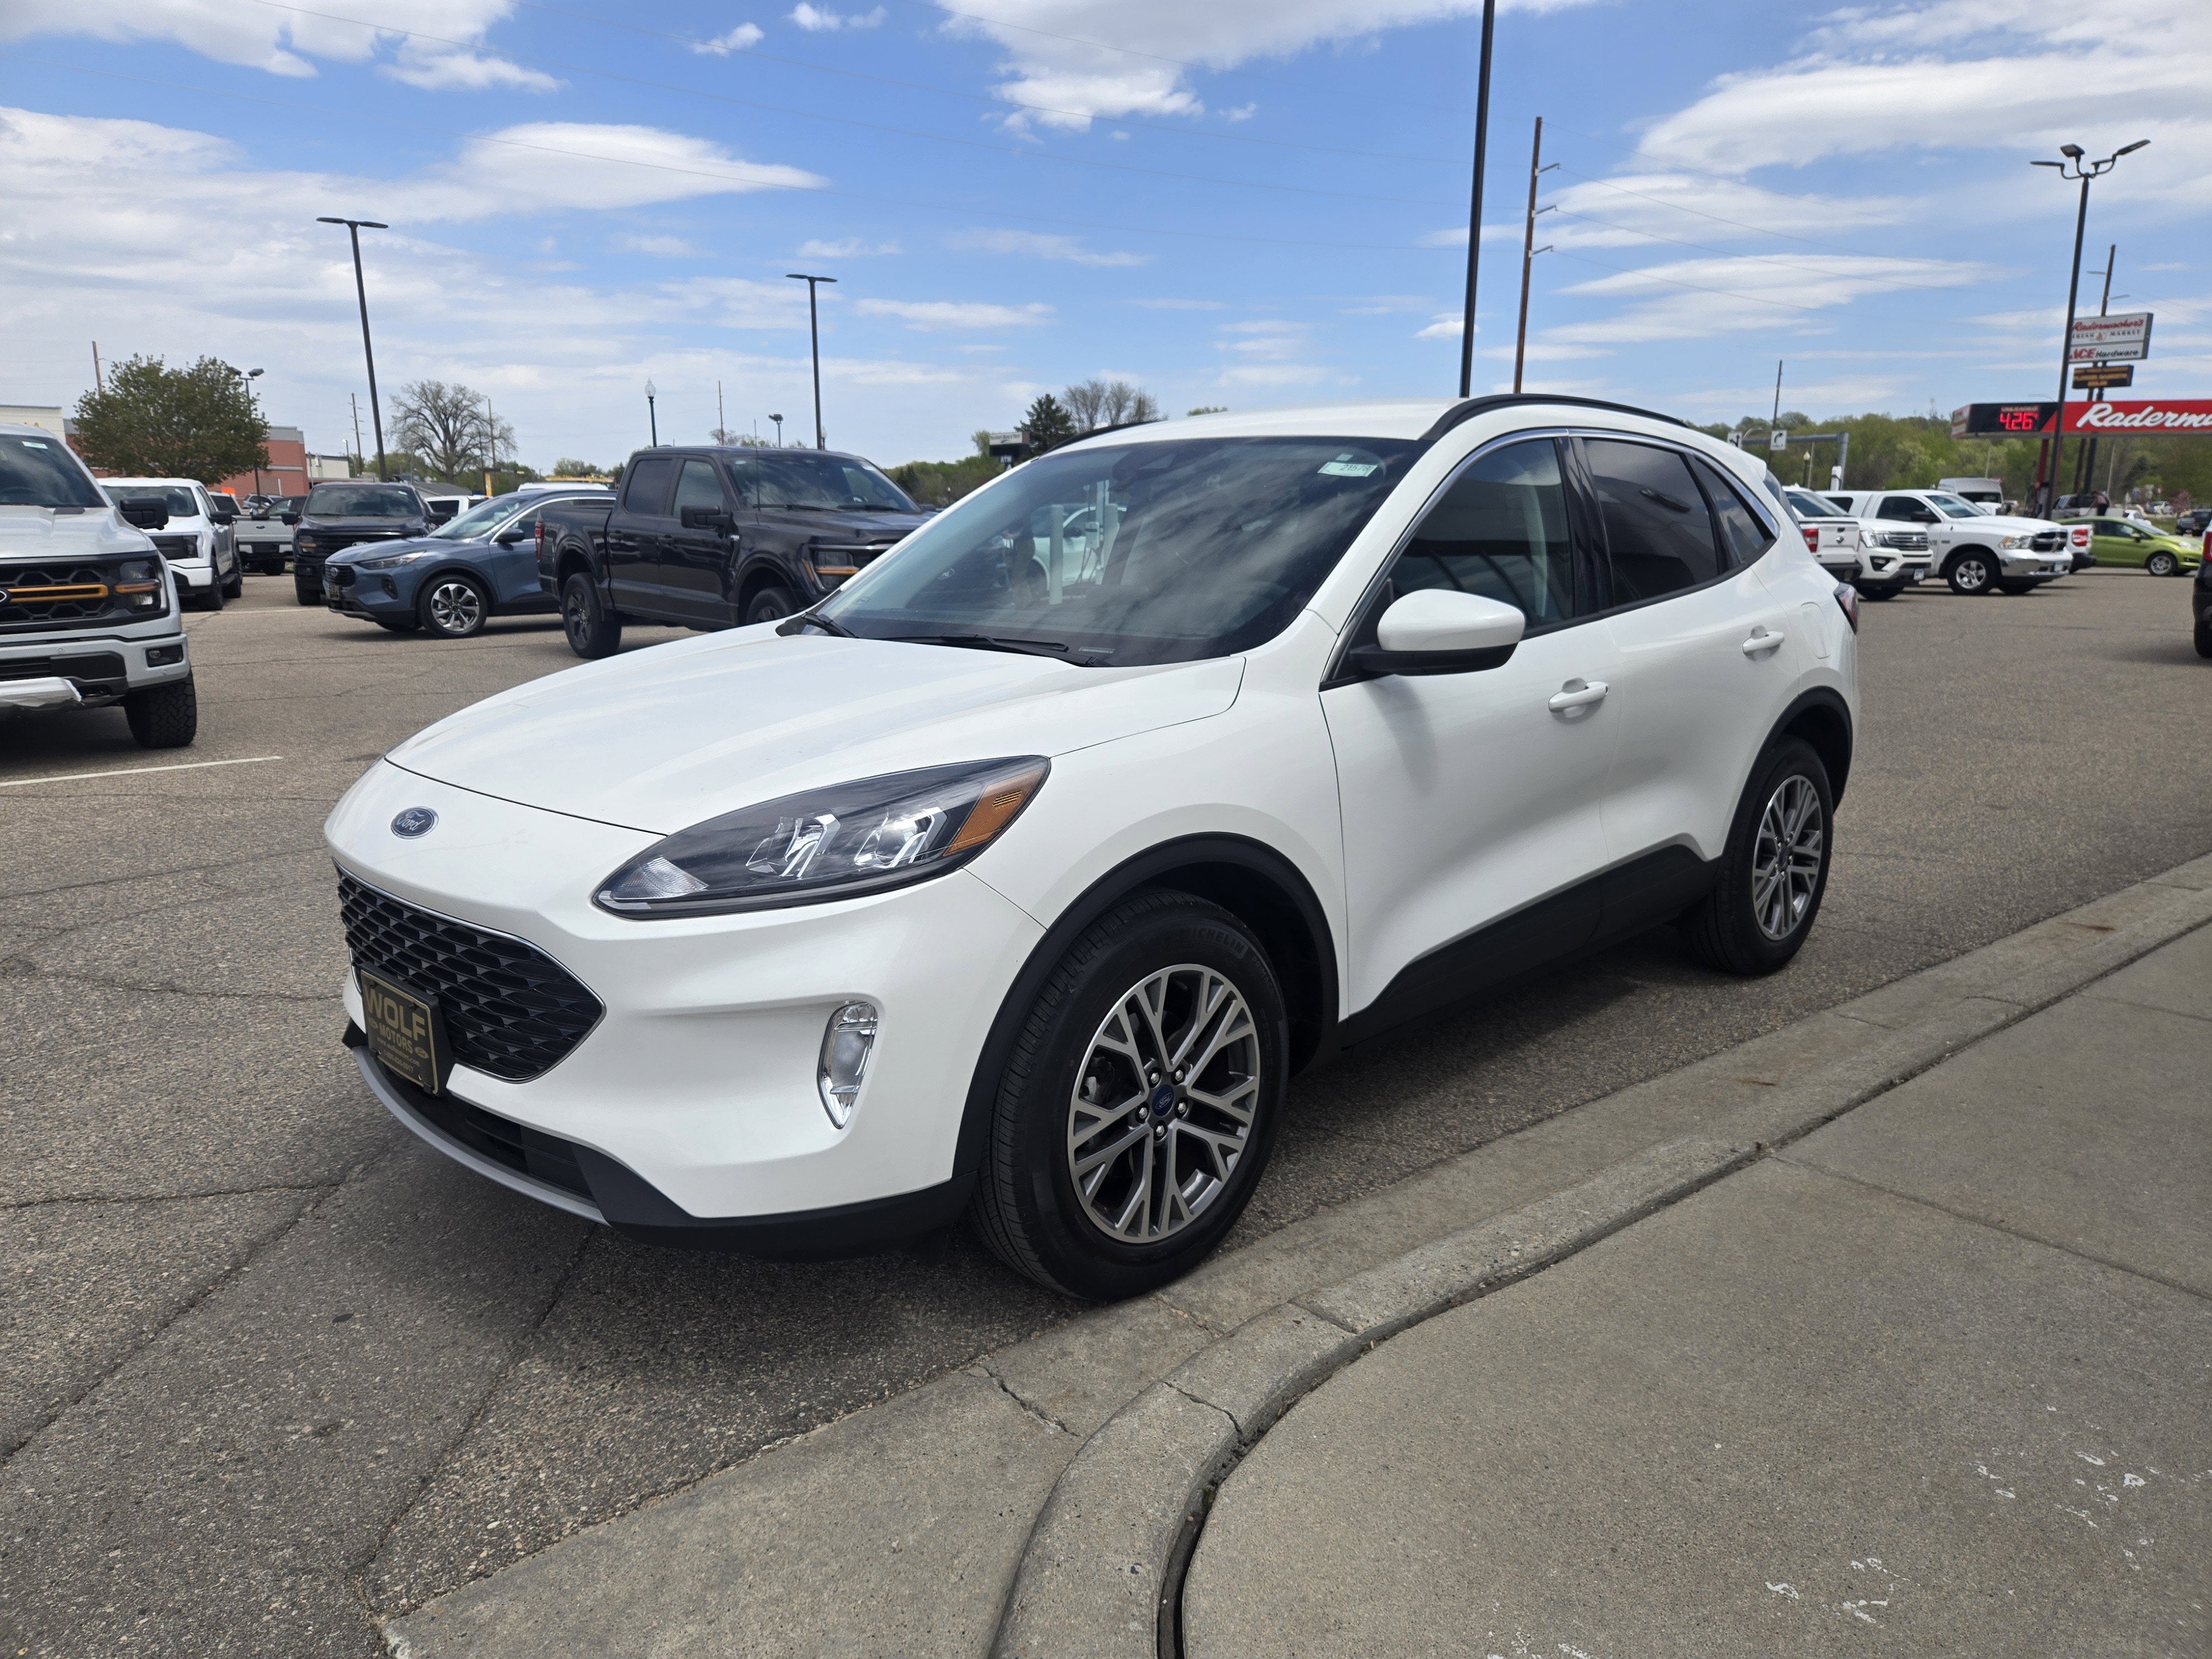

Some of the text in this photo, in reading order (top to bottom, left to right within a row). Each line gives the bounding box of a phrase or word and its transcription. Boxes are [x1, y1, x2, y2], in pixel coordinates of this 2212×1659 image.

[2069, 348, 2139, 360] ACE Hardware
[396, 810, 426, 831] Ford
[1180, 928, 1245, 954] MICHELIN
[363, 983, 426, 1041] WOLF
[379, 1022, 414, 1054] MOTORS
